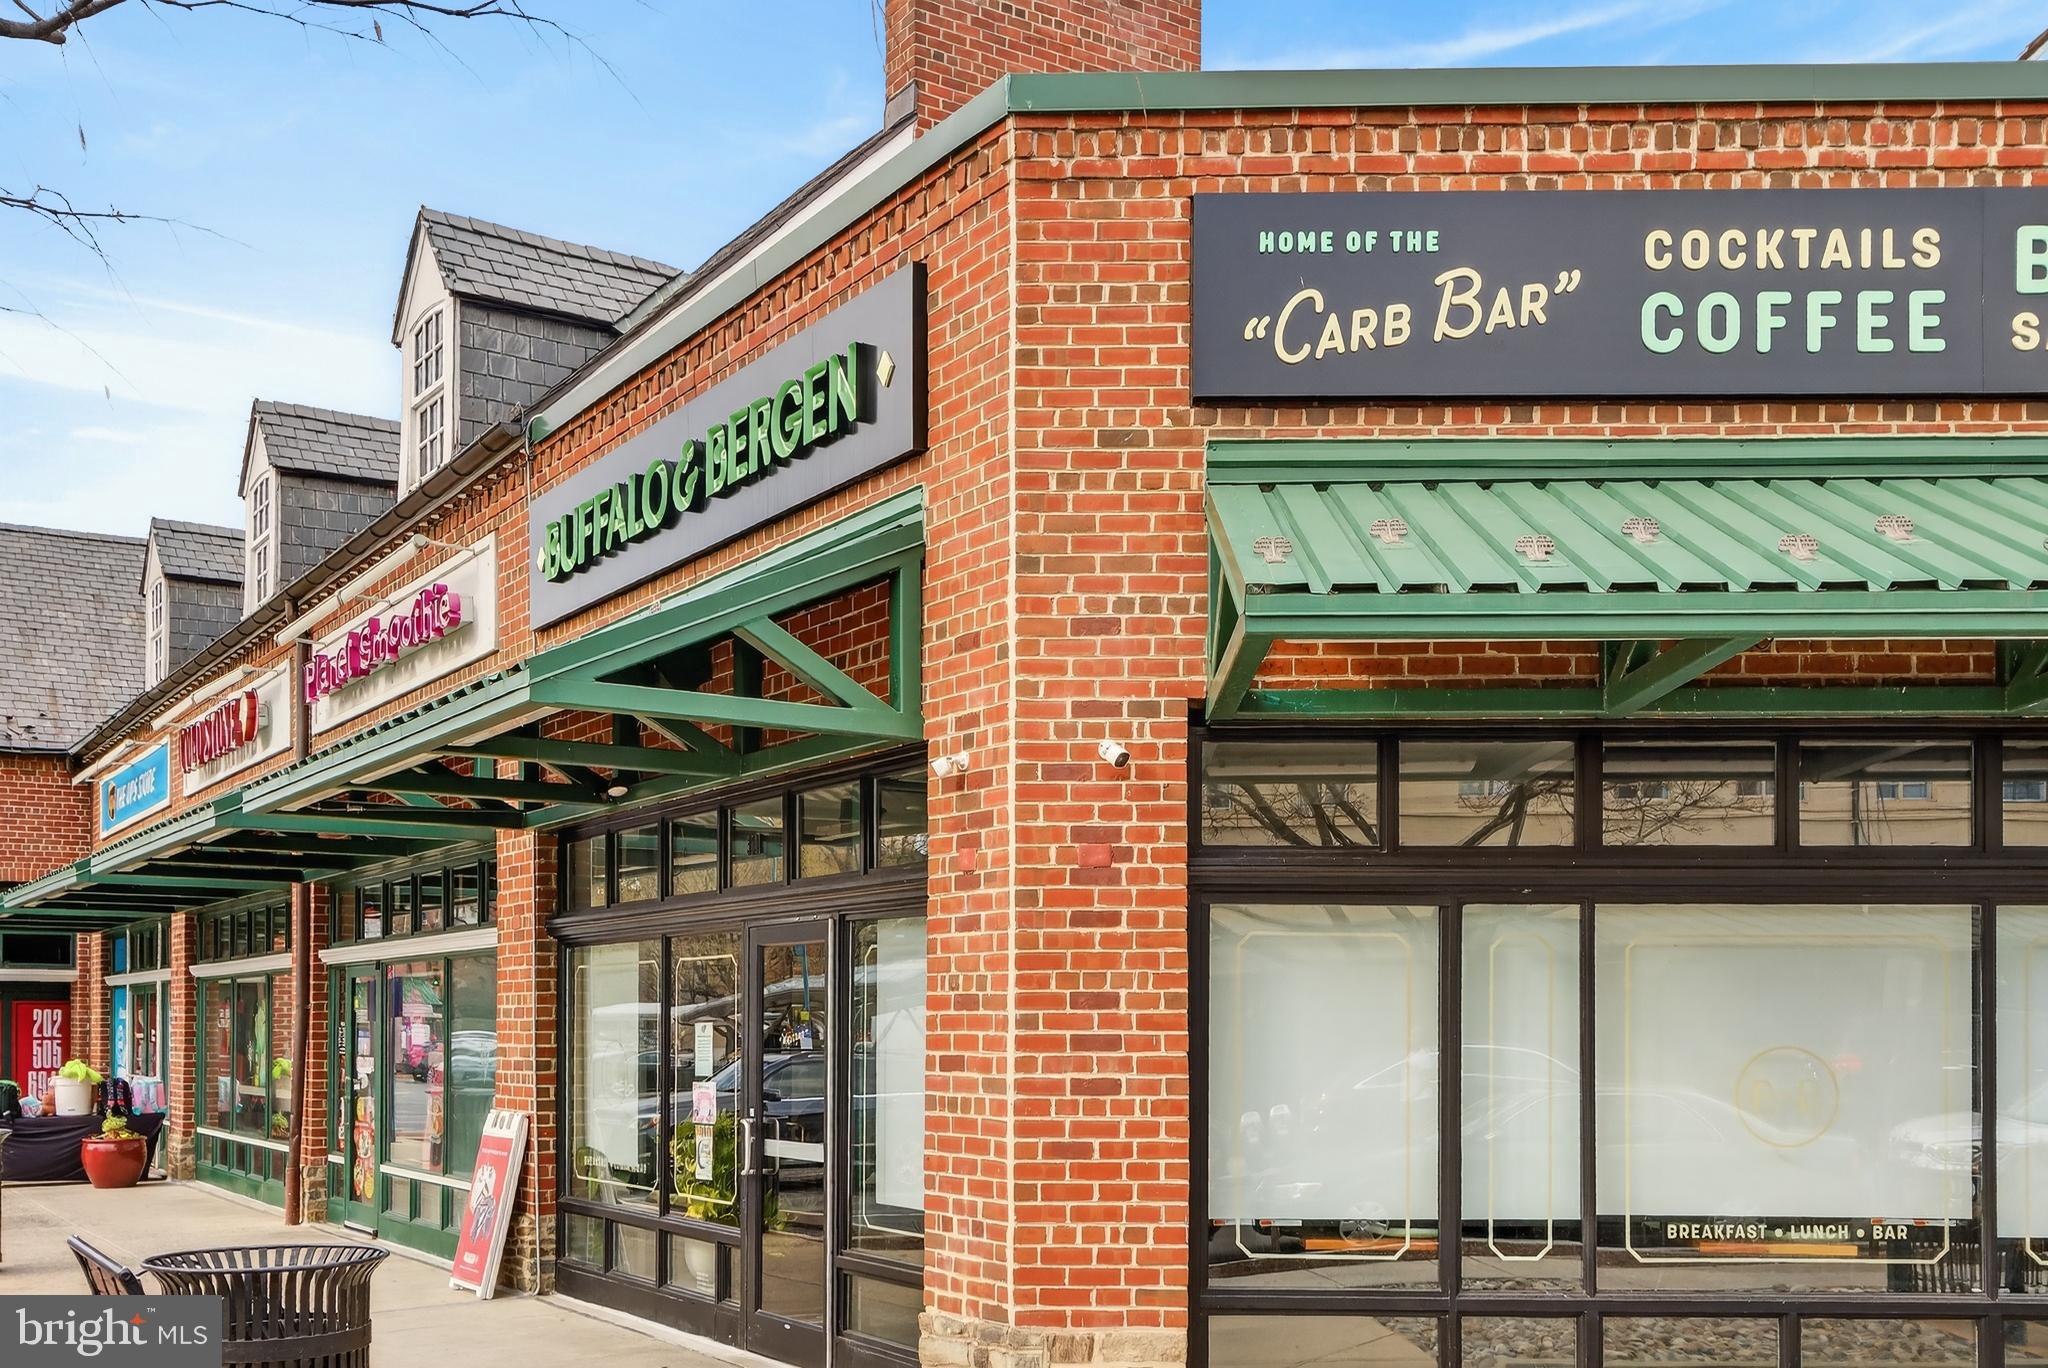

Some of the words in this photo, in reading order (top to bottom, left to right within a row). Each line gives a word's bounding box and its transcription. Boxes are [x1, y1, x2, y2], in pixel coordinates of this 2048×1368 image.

[1259, 231, 1335, 254] HOME
[1345, 231, 1381, 254] OF
[1389, 230, 1441, 253] THE
[1644, 227, 1942, 271] COCKTAILS
[1641, 289, 1947, 355] COFFEE
[545, 458, 669, 583] BUFFALO
[705, 341, 858, 498] BERGEN
[32, 1008, 63, 1038] 202
[32, 1040, 62, 1069] 505
[1666, 1223, 1768, 1240] BREAKFAST
[1790, 1224, 1849, 1240] LUNCH
[1872, 1224, 1908, 1240] BAR
